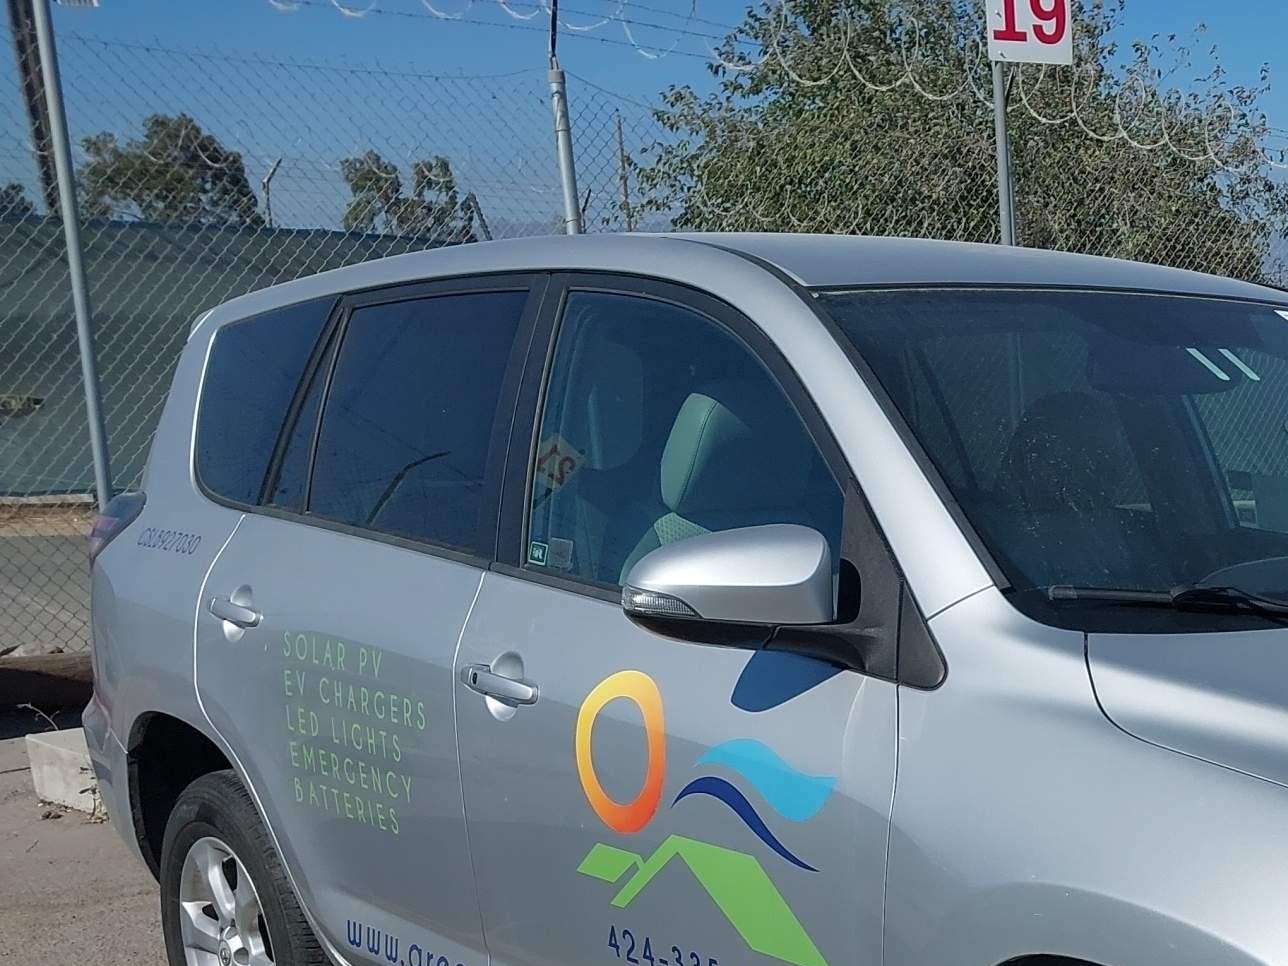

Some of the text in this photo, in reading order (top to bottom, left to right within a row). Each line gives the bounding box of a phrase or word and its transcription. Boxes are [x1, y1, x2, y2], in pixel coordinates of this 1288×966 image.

[993, 0, 1066, 45] 19
[283, 631, 383, 678] SOLAR PV
[284, 670, 426, 730] EV CHARGERS
[285, 704, 401, 762] LED LIGHTS
[289, 741, 411, 803] EMERGENCY
[294, 776, 399, 834] BATTERIES
